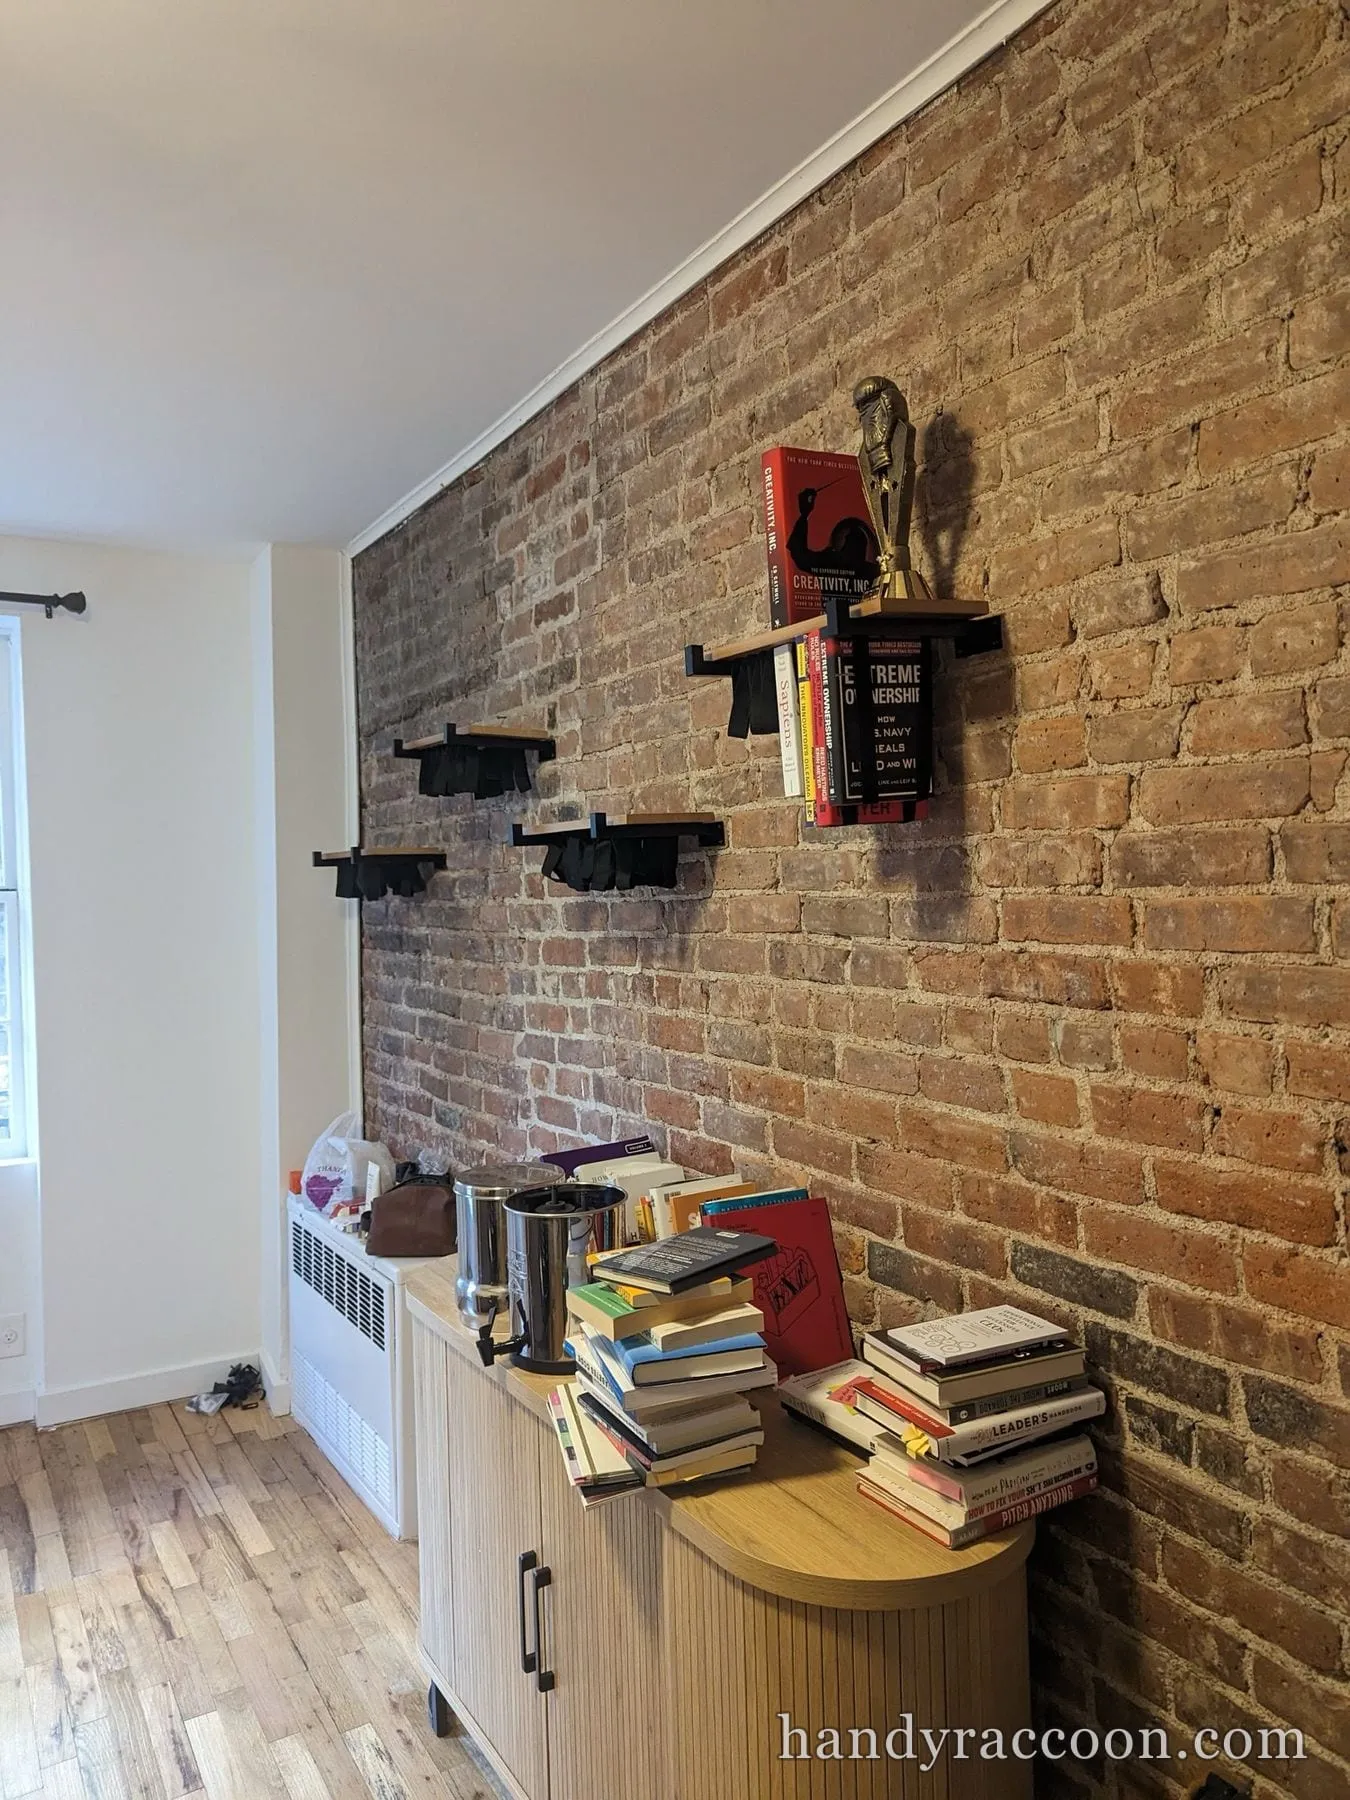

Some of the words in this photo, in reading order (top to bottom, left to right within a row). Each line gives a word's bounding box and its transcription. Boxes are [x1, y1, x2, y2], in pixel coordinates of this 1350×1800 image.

[768, 531, 777, 554] INC.
[793, 575, 852, 593] CREATIVITY,
[821, 641, 829, 686] EXTREME
[780, 680, 793, 749] Sapiens
[823, 687, 833, 749] OWNERSHIP
[877, 715, 895, 723] HOW
[883, 727, 912, 737] NAVY
[875, 743, 905, 753] EALS
[992, 1412, 1048, 1437] LEADER'S
[1049, 1405, 1083, 1419] HANDBOOK
[968, 1506, 985, 1520] HOW
[986, 1502, 995, 1514] TO
[1001, 1501, 1029, 1527] PITCH
[1030, 1484, 1074, 1518] ANYTHING
